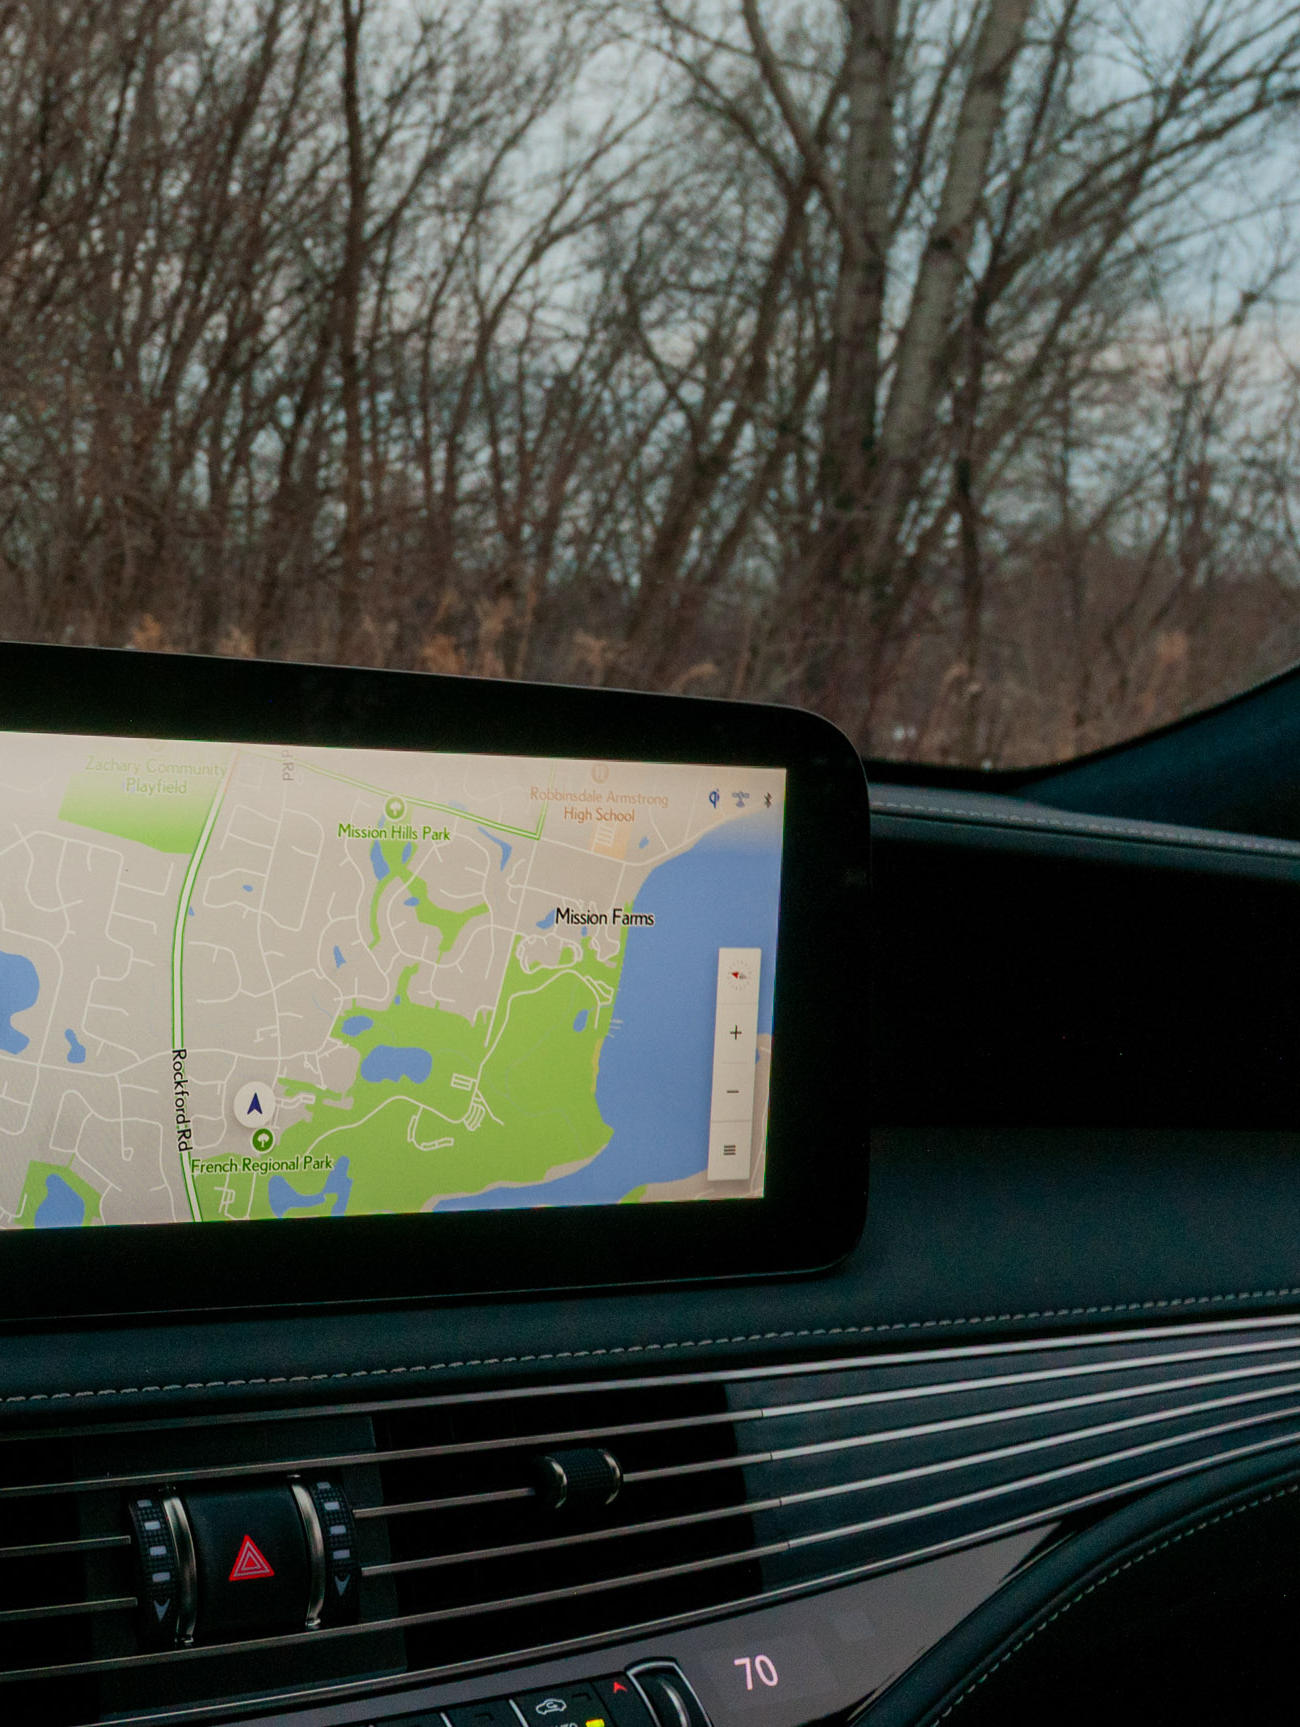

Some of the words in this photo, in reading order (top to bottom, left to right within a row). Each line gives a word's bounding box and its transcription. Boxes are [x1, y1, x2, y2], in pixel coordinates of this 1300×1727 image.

[85, 756, 140, 774] Zachary
[146, 759, 228, 778] Community
[125, 779, 187, 796] Playfield
[530, 786, 603, 803] Robbinsdale
[606, 792, 669, 808] Armstrong
[563, 806, 593, 824] High
[596, 807, 635, 823] School
[337, 823, 388, 840] Mission
[391, 825, 419, 841] Hills
[422, 827, 451, 842] Park
[555, 907, 609, 926] Mission
[612, 909, 655, 926] Farms
[171, 1048, 192, 1125] Rockford
[175, 1127, 193, 1152] Rd
[190, 1157, 239, 1174] French
[241, 1156, 300, 1175] Regional
[303, 1155, 333, 1171] Park
[734, 1654, 779, 1690] 70
